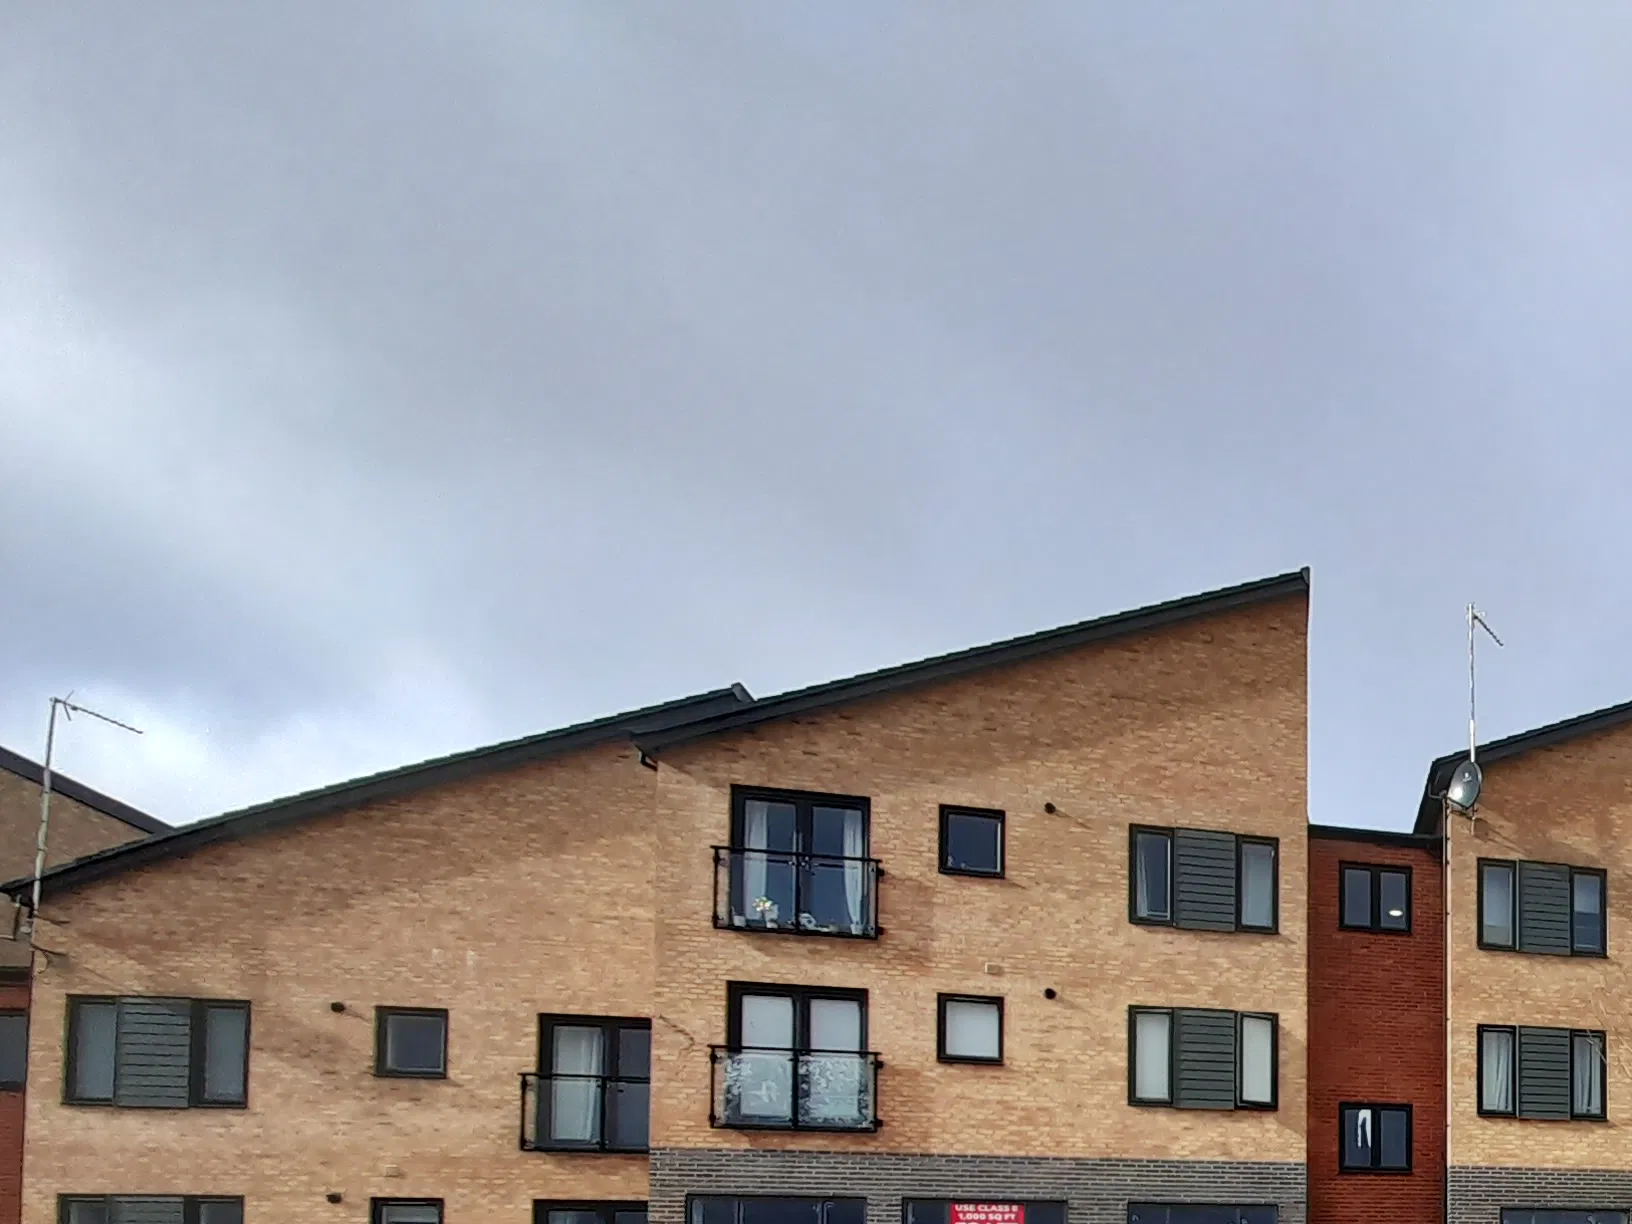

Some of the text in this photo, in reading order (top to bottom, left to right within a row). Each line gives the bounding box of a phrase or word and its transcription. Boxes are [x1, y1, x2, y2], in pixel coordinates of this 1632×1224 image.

[954, 1204, 977, 1212] USE
[987, 1213, 1003, 1221] SQ
[1003, 1213, 1017, 1221] FT
